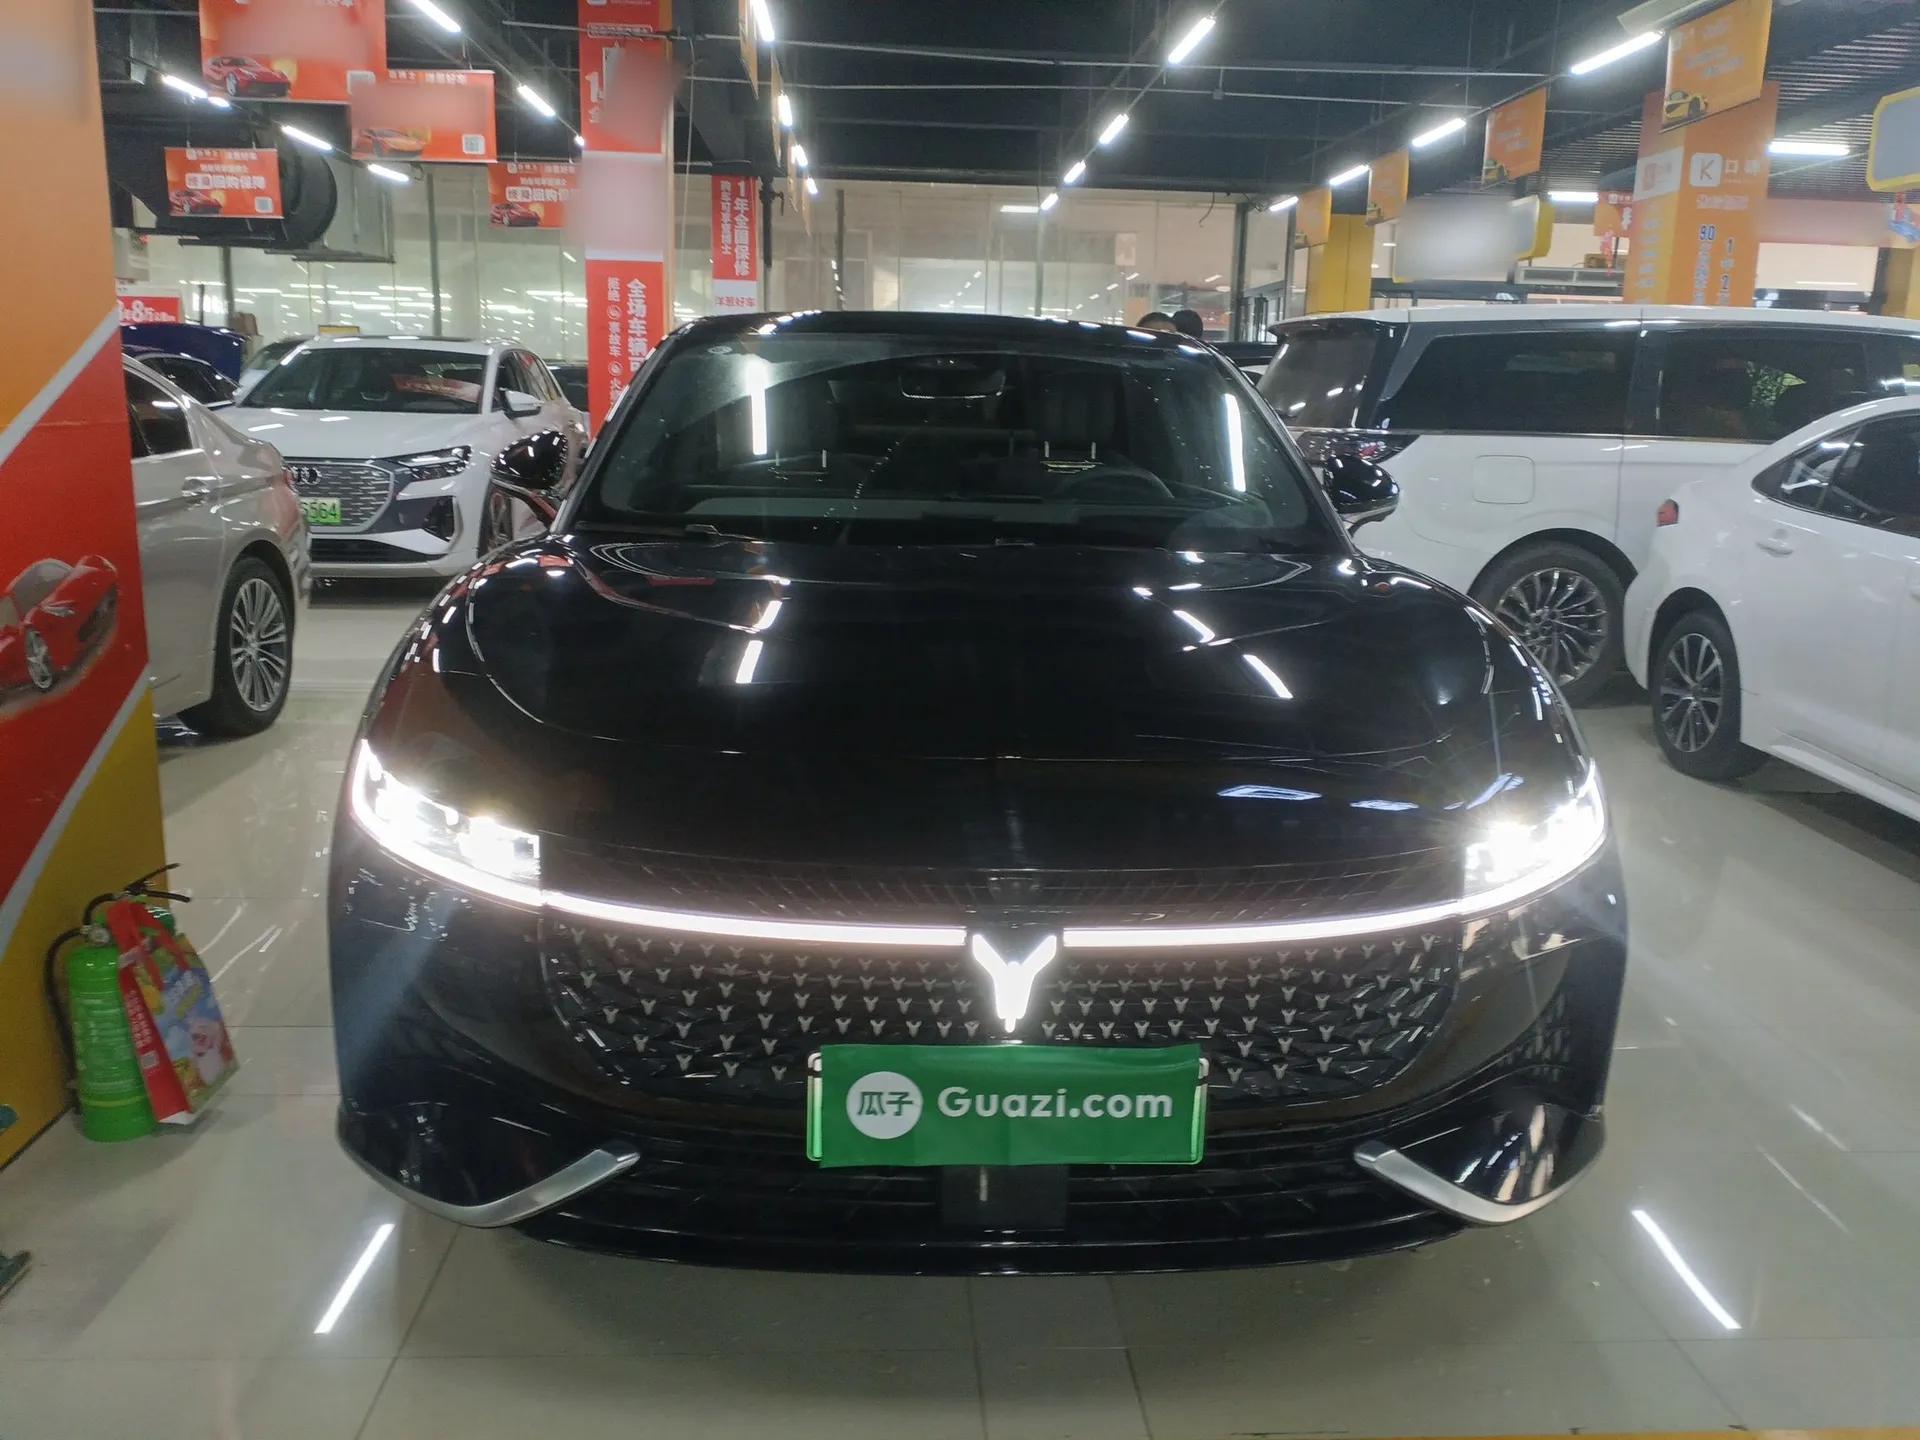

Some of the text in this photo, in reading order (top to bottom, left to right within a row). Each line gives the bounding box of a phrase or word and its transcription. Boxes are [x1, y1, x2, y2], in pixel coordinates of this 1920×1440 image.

[734, 180, 751, 277] 1年全国保修
[627, 278, 648, 373] 全场车辆可
[857, 1091, 914, 1117] 瓜子
[937, 1086, 1174, 1119] Guazi.com
